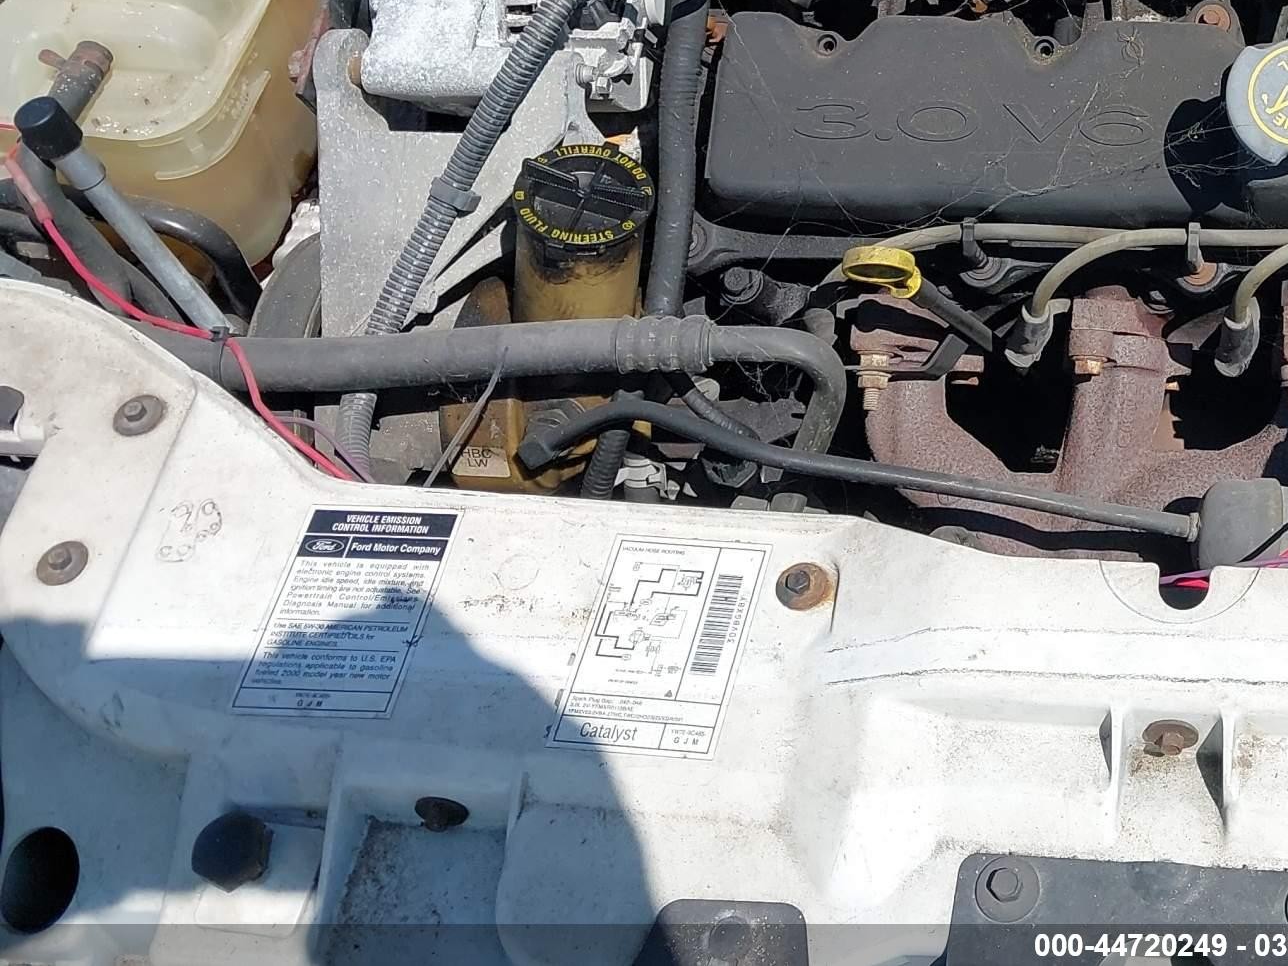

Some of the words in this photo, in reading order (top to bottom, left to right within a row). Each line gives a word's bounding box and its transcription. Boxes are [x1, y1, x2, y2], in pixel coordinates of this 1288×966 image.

[793, 104, 978, 142] 3.0
[1002, 104, 1154, 146] V6
[552, 145, 611, 158] OVERFILL
[614, 153, 636, 169] NOT
[632, 168, 647, 181] DO
[520, 207, 549, 233] FLUID
[551, 228, 614, 243] STEERING
[467, 457, 488, 468] LW
[346, 514, 380, 524] VEHICLE
[381, 515, 422, 525] EMISSION
[332, 523, 370, 532] CONTROL
[372, 524, 429, 534] INFORMATION
[312, 541, 336, 551] Ford
[351, 542, 371, 552] Ford
[373, 543, 399, 553] Motor
[400, 545, 441, 555] Company
[370, 562, 408, 571] equipped
[297, 568, 333, 576] electronic
[336, 570, 361, 578] engine
[293, 576, 319, 584] Engine
[287, 592, 332, 600] Powertrain
[283, 600, 322, 608] Diagnosis
[327, 601, 356, 609] Manual
[282, 652, 308, 660] vehicle
[311, 653, 347, 662] conforms
[305, 662, 345, 671] applicable
[359, 664, 393, 672] gasoline
[303, 670, 327, 678] model
[580, 722, 638, 742] Catalyst
